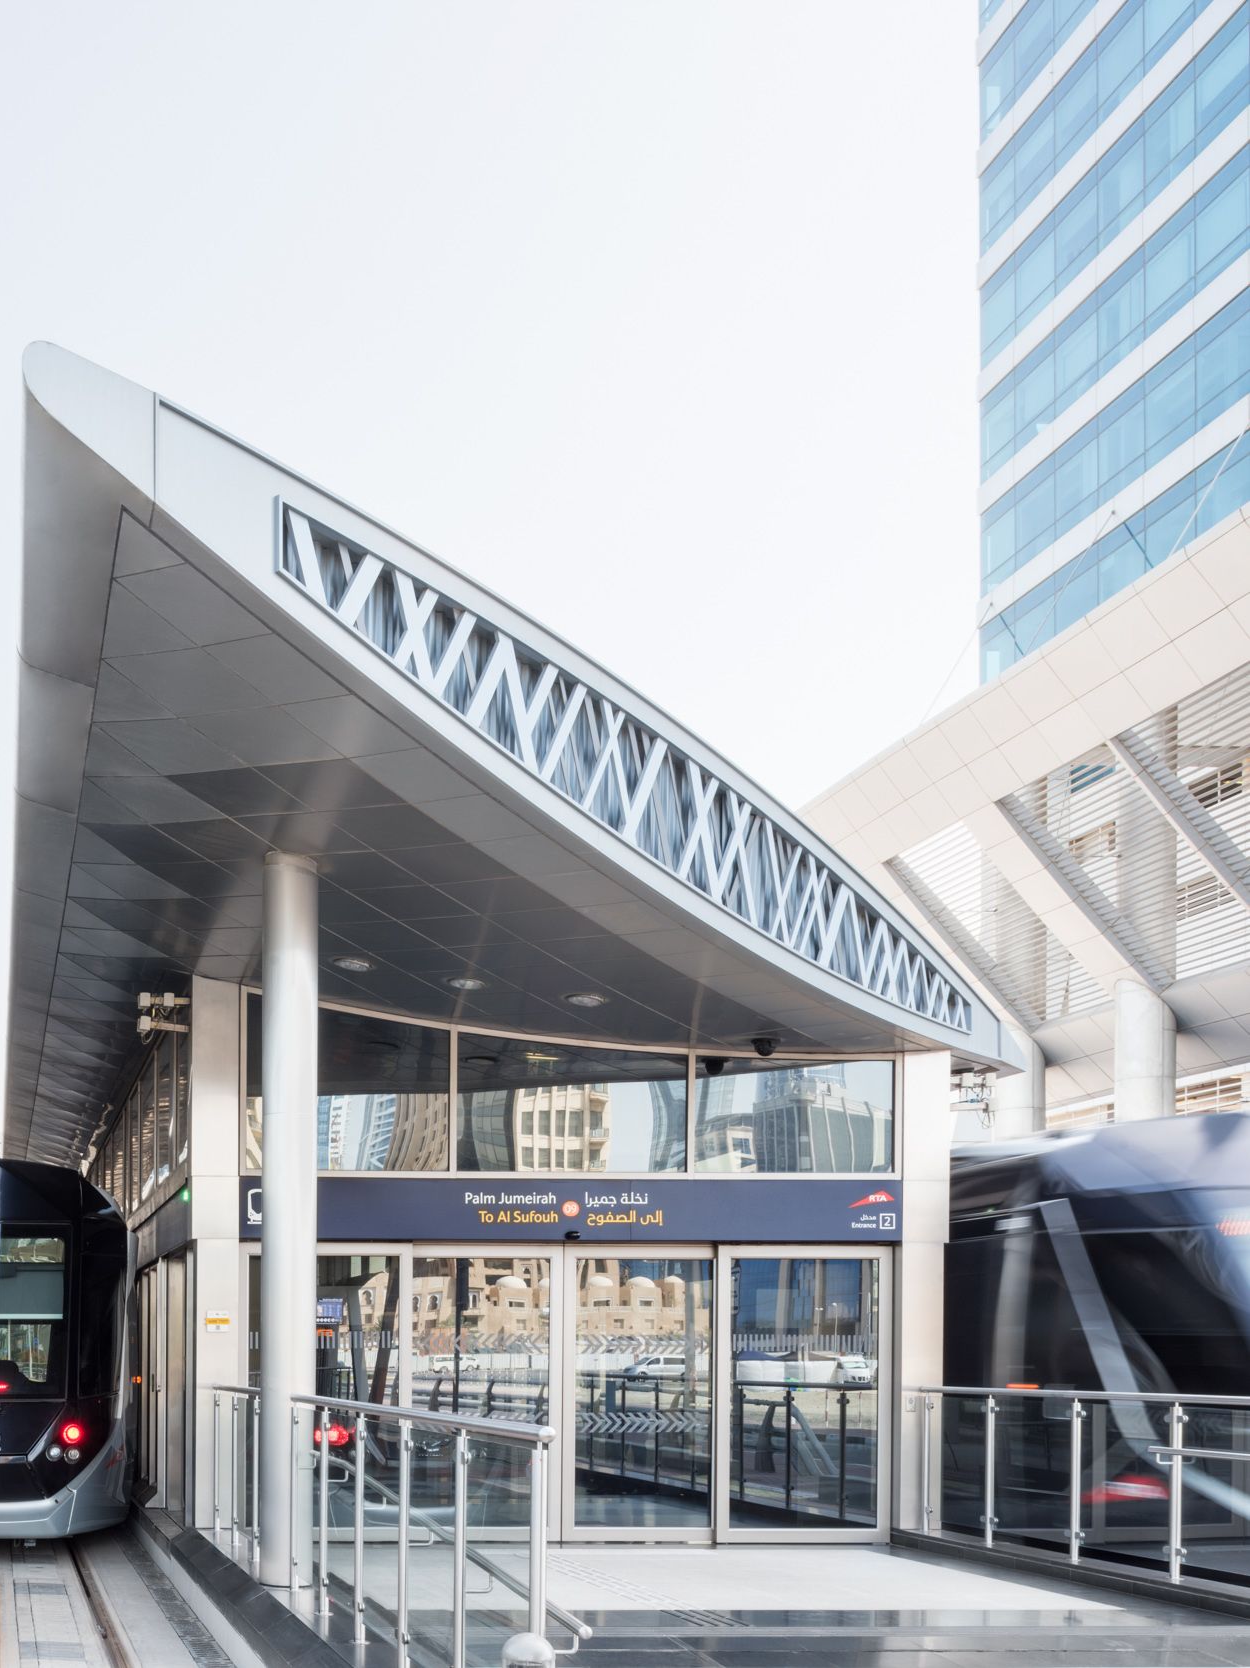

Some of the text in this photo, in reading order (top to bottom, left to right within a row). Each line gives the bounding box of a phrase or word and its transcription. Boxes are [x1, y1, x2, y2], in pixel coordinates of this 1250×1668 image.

[464, 1192, 556, 1205] Palm Jumeirah
[584, 1191, 648, 1208] نخلة جميرا
[478, 1210, 559, 1223] To Al Sufouh
[586, 1209, 663, 1226] إلى الصفوح
[851, 1221, 877, 1229] Entrance
